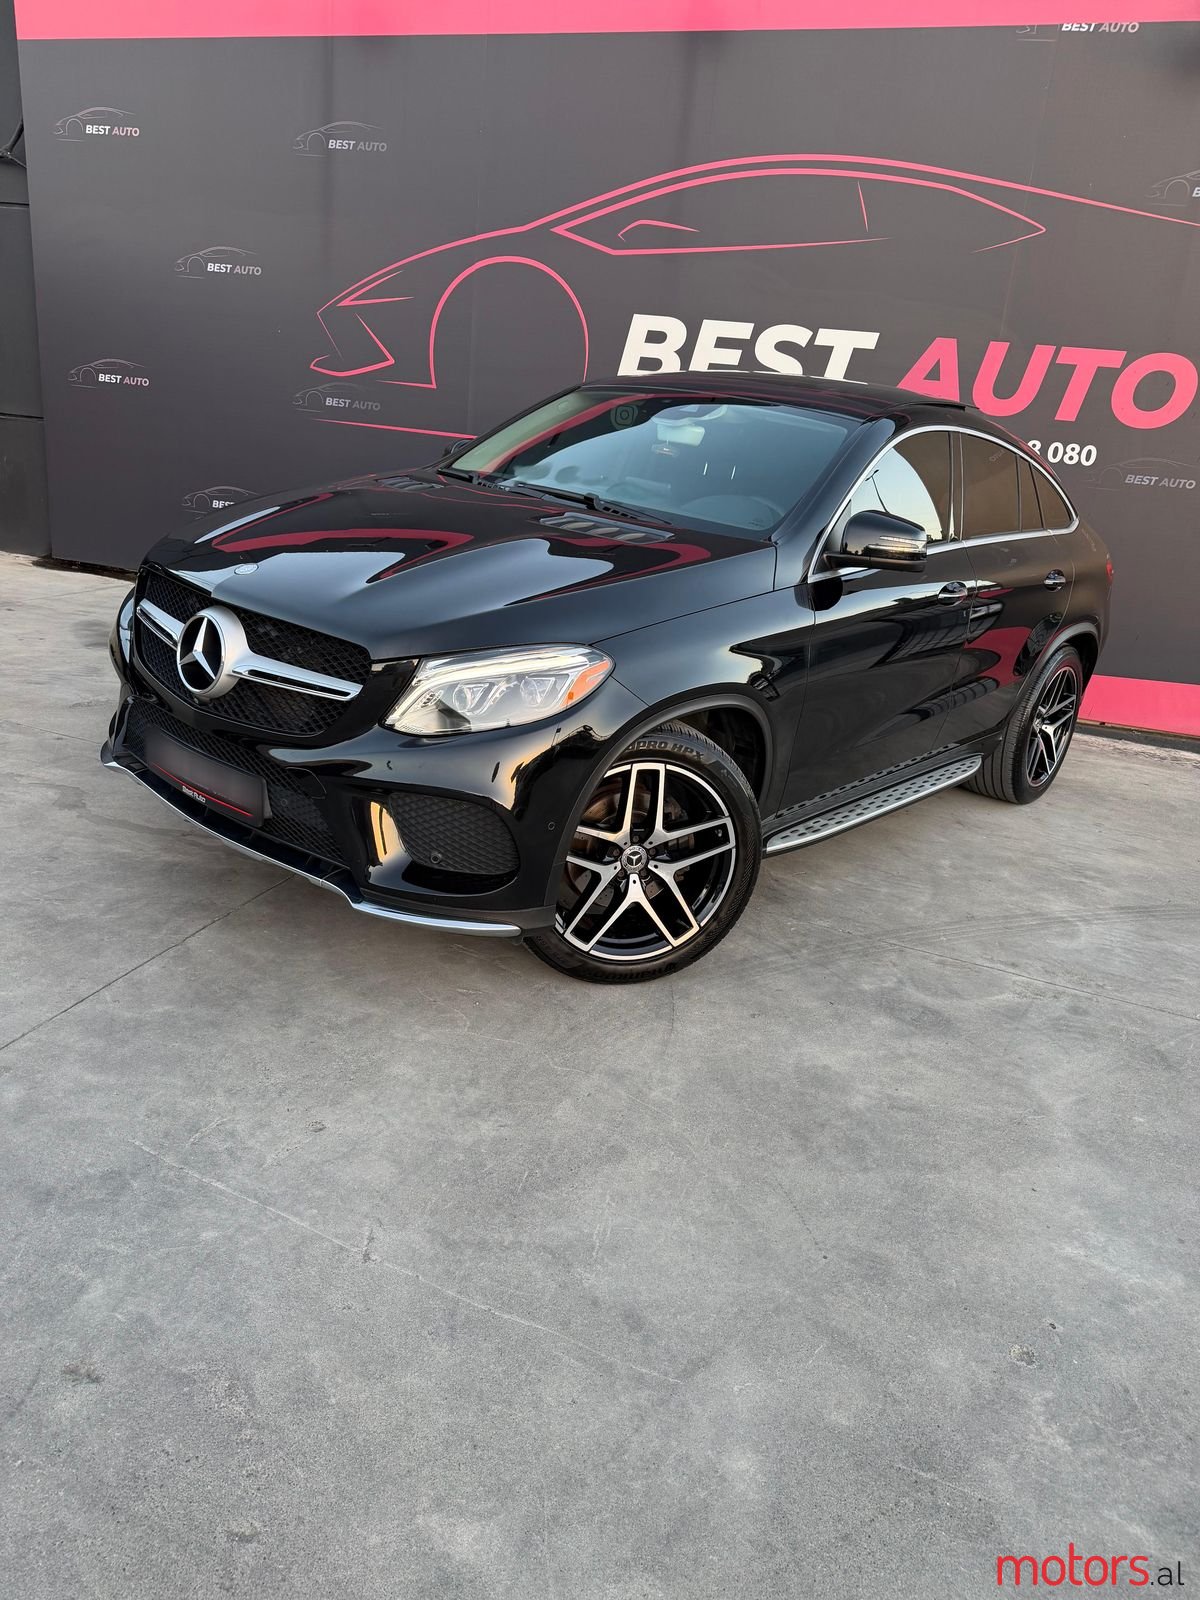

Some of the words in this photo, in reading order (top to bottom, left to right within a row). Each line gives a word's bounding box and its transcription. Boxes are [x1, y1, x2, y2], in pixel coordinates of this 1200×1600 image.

[1061, 22, 1097, 32] BEST
[1099, 22, 1140, 33] AUTO
[85, 124, 111, 135] BEST
[112, 126, 140, 137] AUTO
[328, 139, 356, 150] BEST
[356, 141, 388, 152] AUTO
[207, 262, 233, 273] BEST
[233, 265, 262, 276] AUTO
[617, 313, 880, 381] BEST
[896, 337, 1199, 430] AUTO
[98, 373, 122, 384] BEST
[123, 376, 150, 387] AUTO
[325, 396, 352, 408] BEST
[352, 400, 381, 411] AUTO
[1047, 442, 1097, 467] 080
[1124, 474, 1159, 486] BEST
[1159, 478, 1196, 489] AUTO
